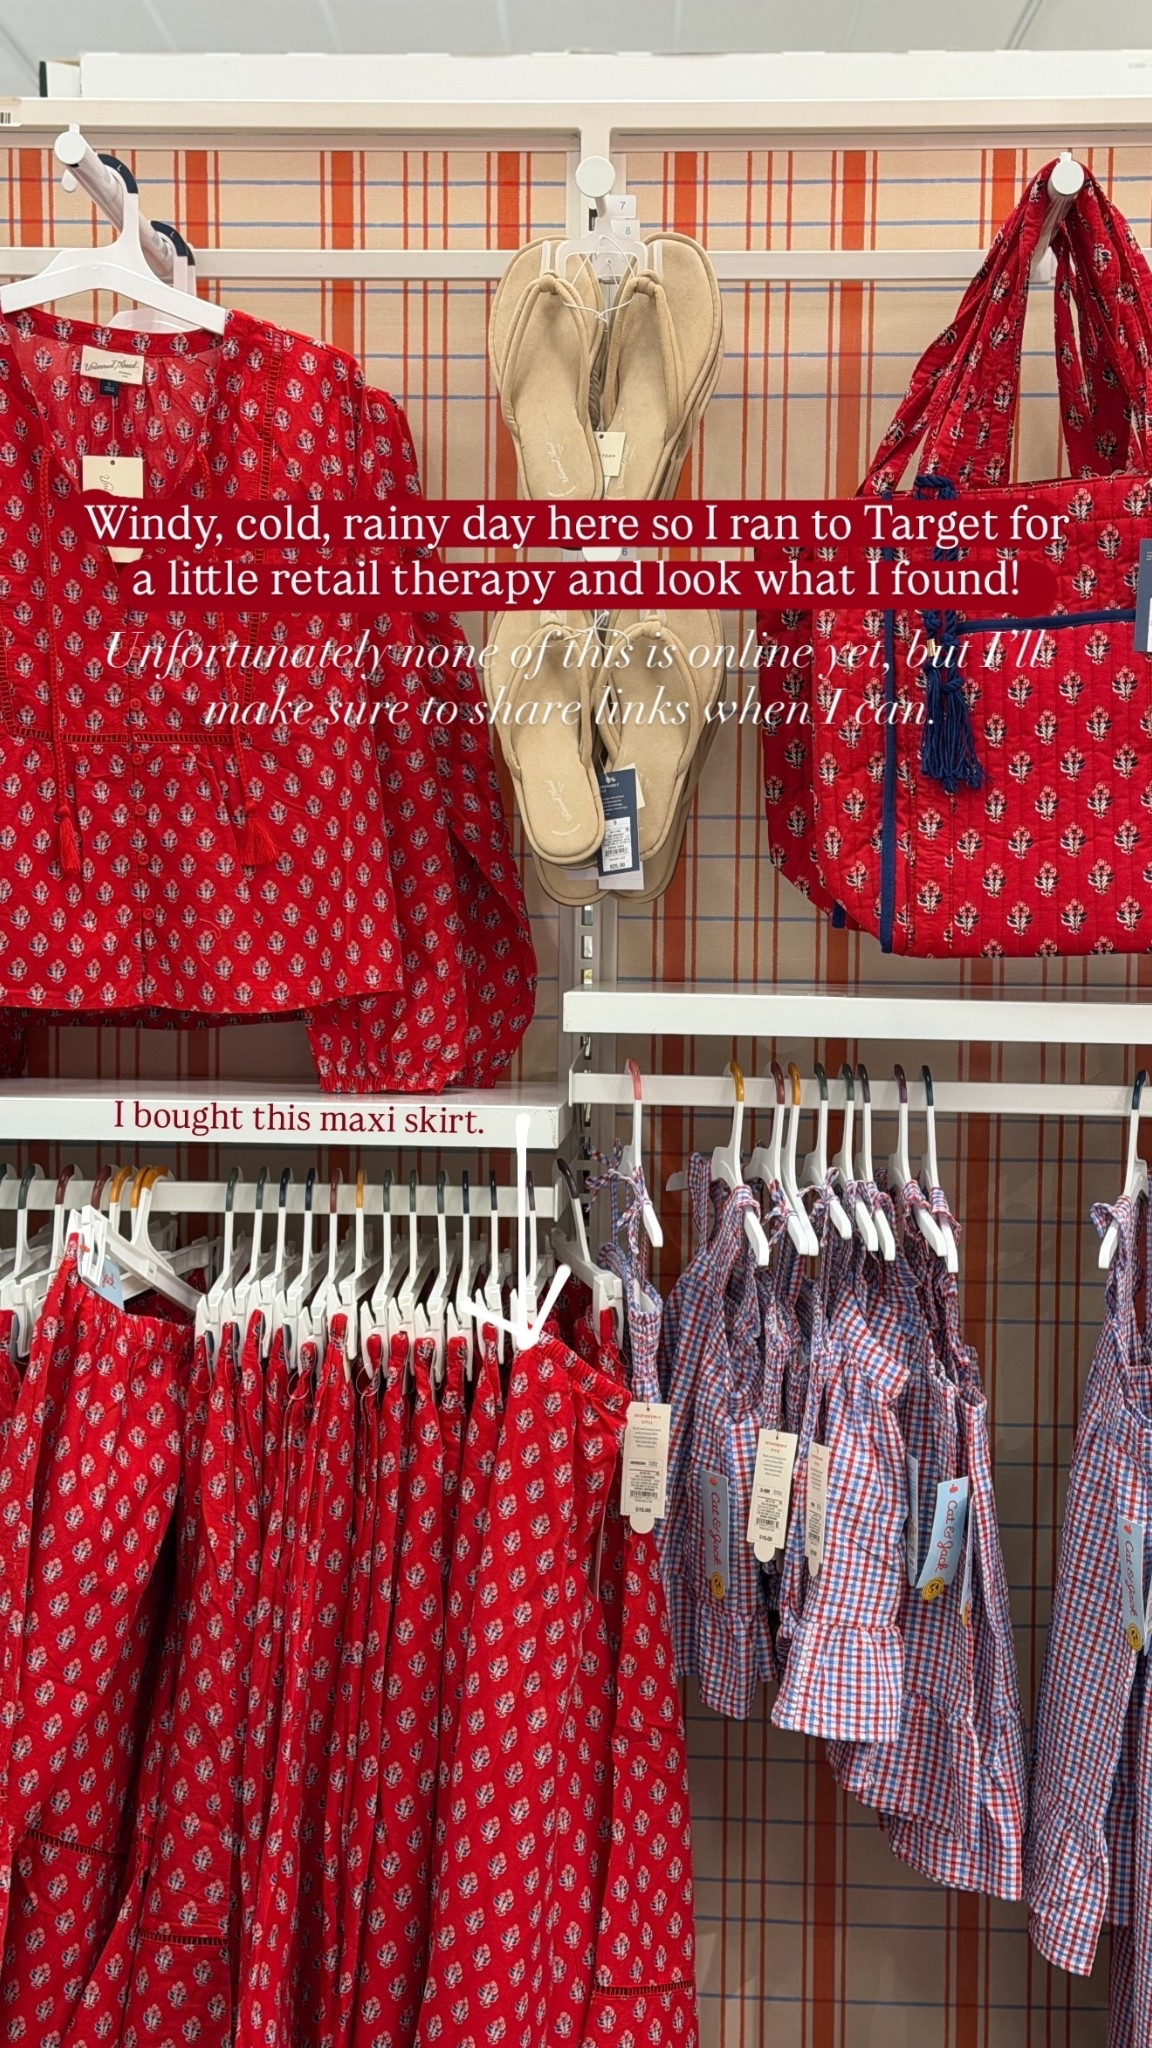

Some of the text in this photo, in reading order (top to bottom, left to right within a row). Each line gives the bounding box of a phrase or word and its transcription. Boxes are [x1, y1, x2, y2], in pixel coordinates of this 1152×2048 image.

[619, 201, 626, 210] 7
[622, 547, 628, 556] 6
[711, 1492, 720, 1516] Cat
[945, 1500, 958, 1525] Cat
[709, 1529, 722, 1565] Jack
[935, 1540, 954, 1573] Jack
[1125, 1540, 1134, 1566] Cat
[1124, 1579, 1138, 1617] Jack
